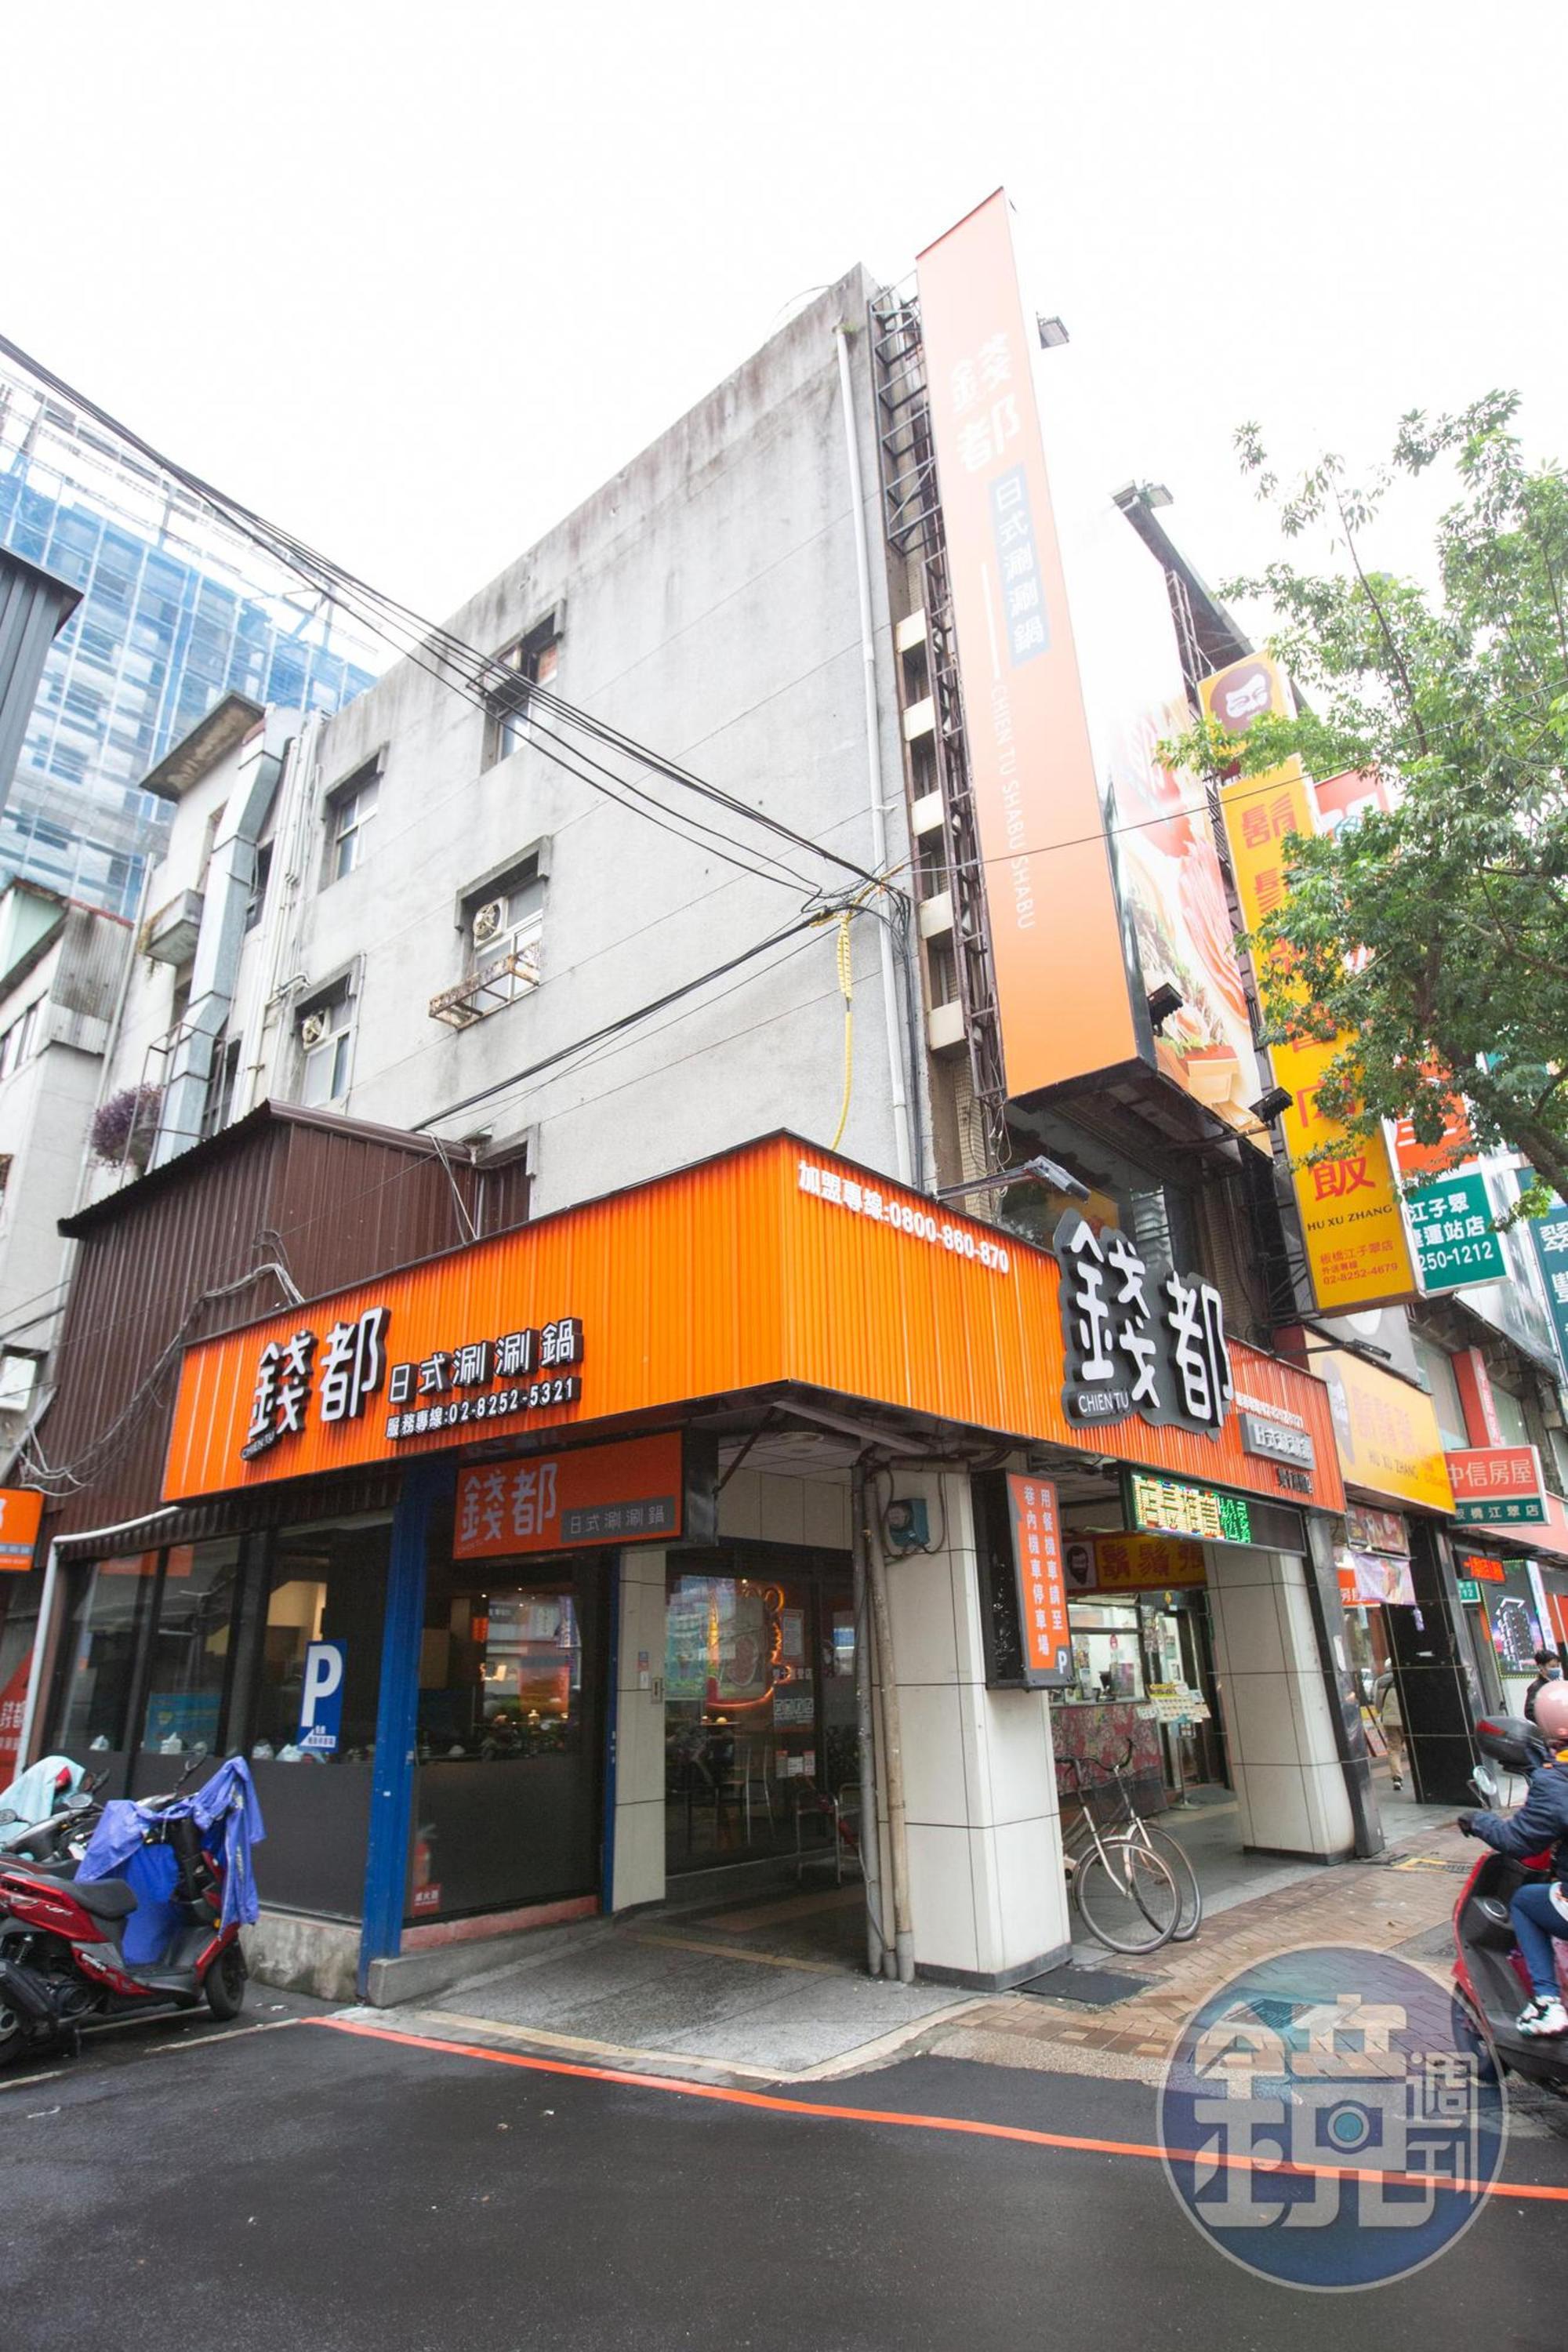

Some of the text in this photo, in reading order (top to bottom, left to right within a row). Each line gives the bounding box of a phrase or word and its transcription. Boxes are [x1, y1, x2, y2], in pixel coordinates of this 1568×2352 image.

[949, 332, 1021, 473] 錢都
[994, 476, 1044, 655] 日式涮涮鍋
[991, 684, 1036, 930] CHIEN TU SHABU SHABU
[1307, 1204, 1393, 1232] HU XU ZHANG
[1407, 1191, 1470, 1223] 江子翠
[388, 1318, 576, 1403] 日式涮涮鍋
[1069, 1220, 1234, 1428] 錢都
[248, 1306, 384, 1437] 錢都
[386, 1377, 574, 1439] 服務專線:02-8252-5321
[1078, 1392, 1130, 1413] CHIEN TU
[460, 1461, 559, 1542] 錢都
[1448, 1459, 1534, 1490] 中信房屋
[569, 1504, 666, 1534] 日式涮涮鍋
[300, 1644, 343, 1727] P
